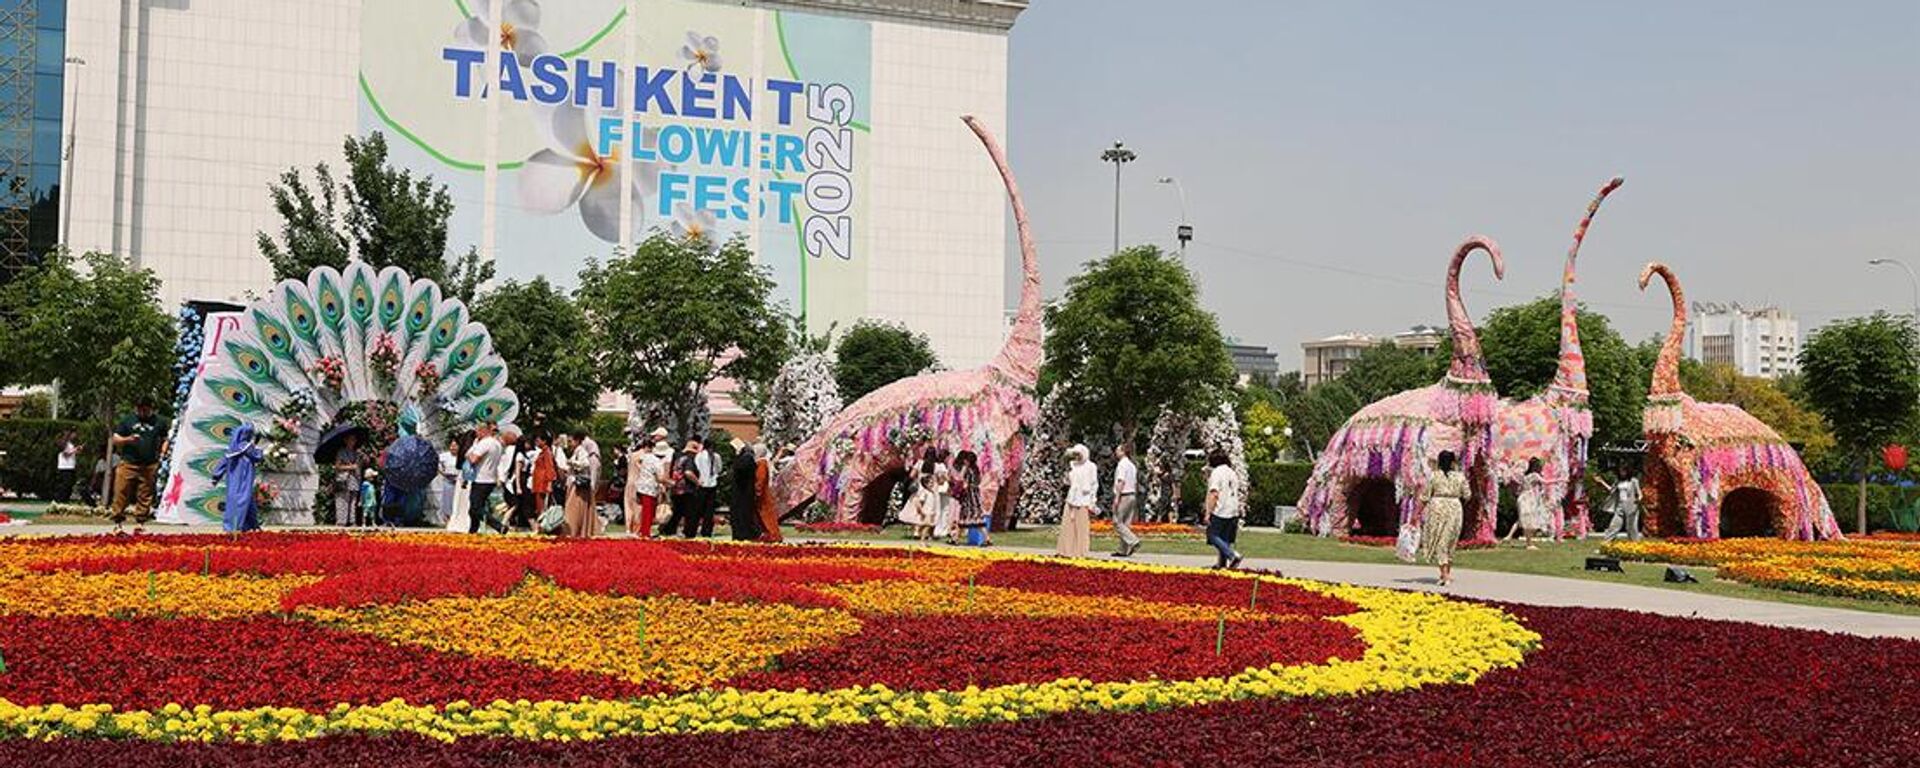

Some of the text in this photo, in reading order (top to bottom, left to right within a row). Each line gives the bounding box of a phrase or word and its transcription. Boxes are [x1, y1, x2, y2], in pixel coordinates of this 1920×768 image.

[598, 118, 805, 173] FLOWER
[804, 83, 855, 261] 2025
[658, 172, 803, 224] FEST
